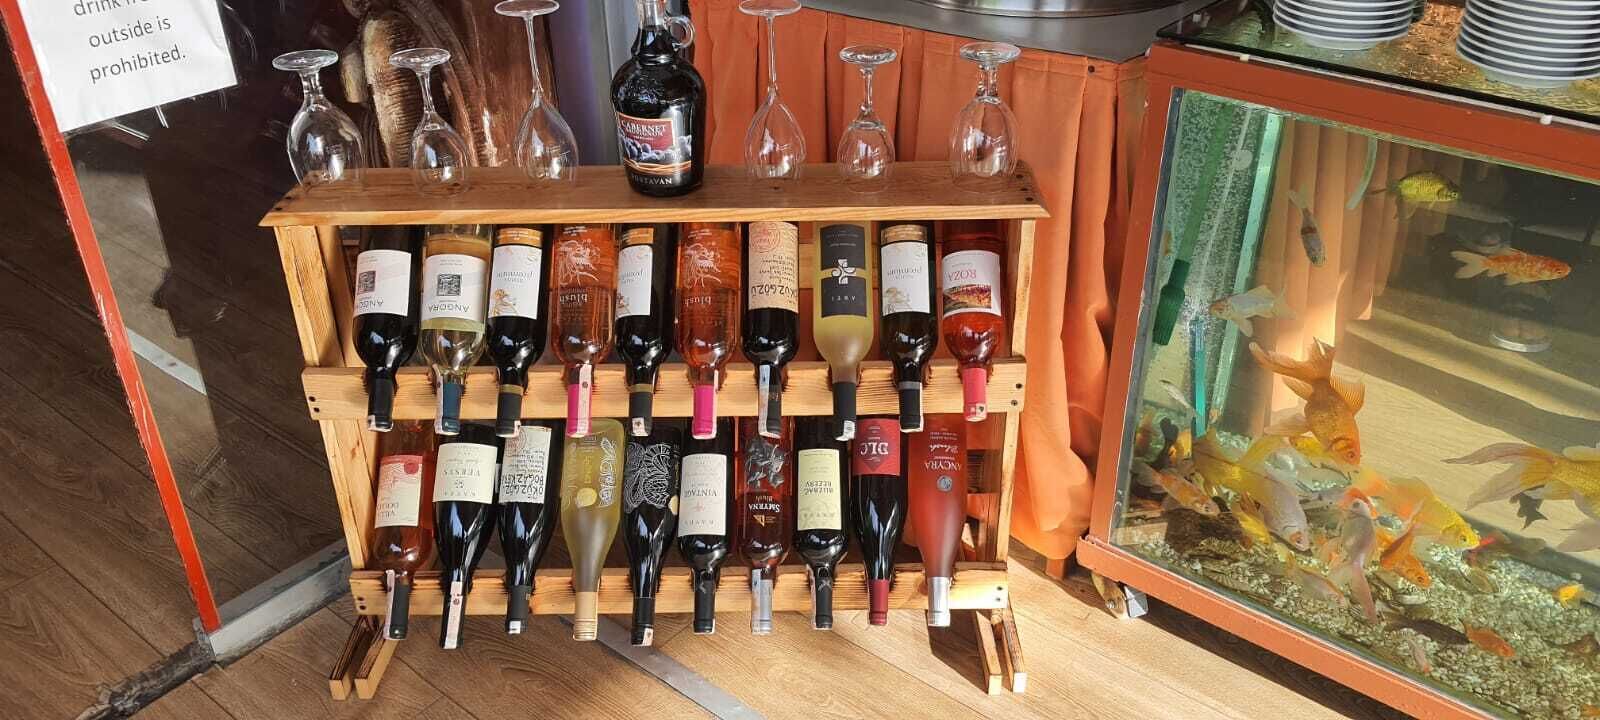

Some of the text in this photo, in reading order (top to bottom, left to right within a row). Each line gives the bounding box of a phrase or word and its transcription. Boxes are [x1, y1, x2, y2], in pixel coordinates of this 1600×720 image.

[89, 15, 171, 48] outside is
[90, 43, 186, 84] prohibited.
[621, 119, 666, 132] CABERNET
[947, 269, 978, 282] ROZA
[559, 294, 588, 305] blush
[683, 295, 711, 308] blush
[428, 303, 470, 313] ANGORA
[860, 442, 889, 455] DLC
[924, 461, 962, 472] ANCYRA
[747, 503, 780, 513] SMYRNA
